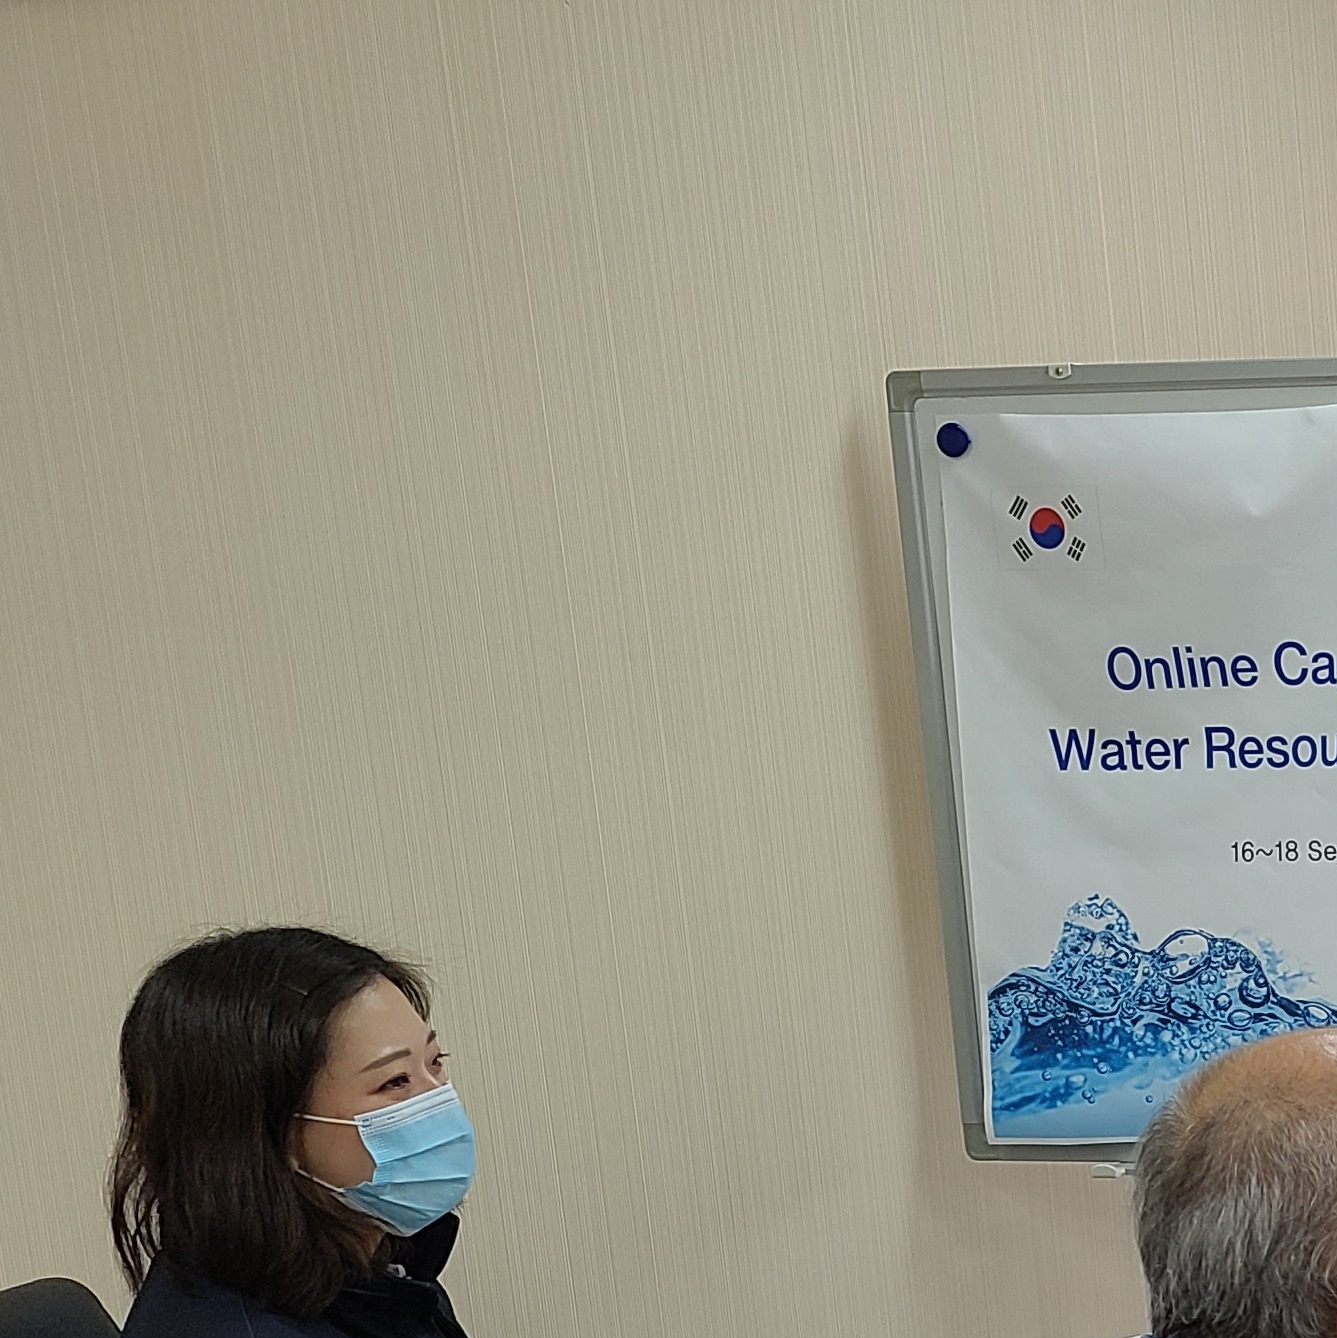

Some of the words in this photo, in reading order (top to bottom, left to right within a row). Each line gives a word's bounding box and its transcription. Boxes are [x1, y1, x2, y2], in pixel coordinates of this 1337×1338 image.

[1106, 644, 1260, 692] Online
[1048, 727, 1190, 772] Water
[1229, 839, 1300, 863] 16~18
